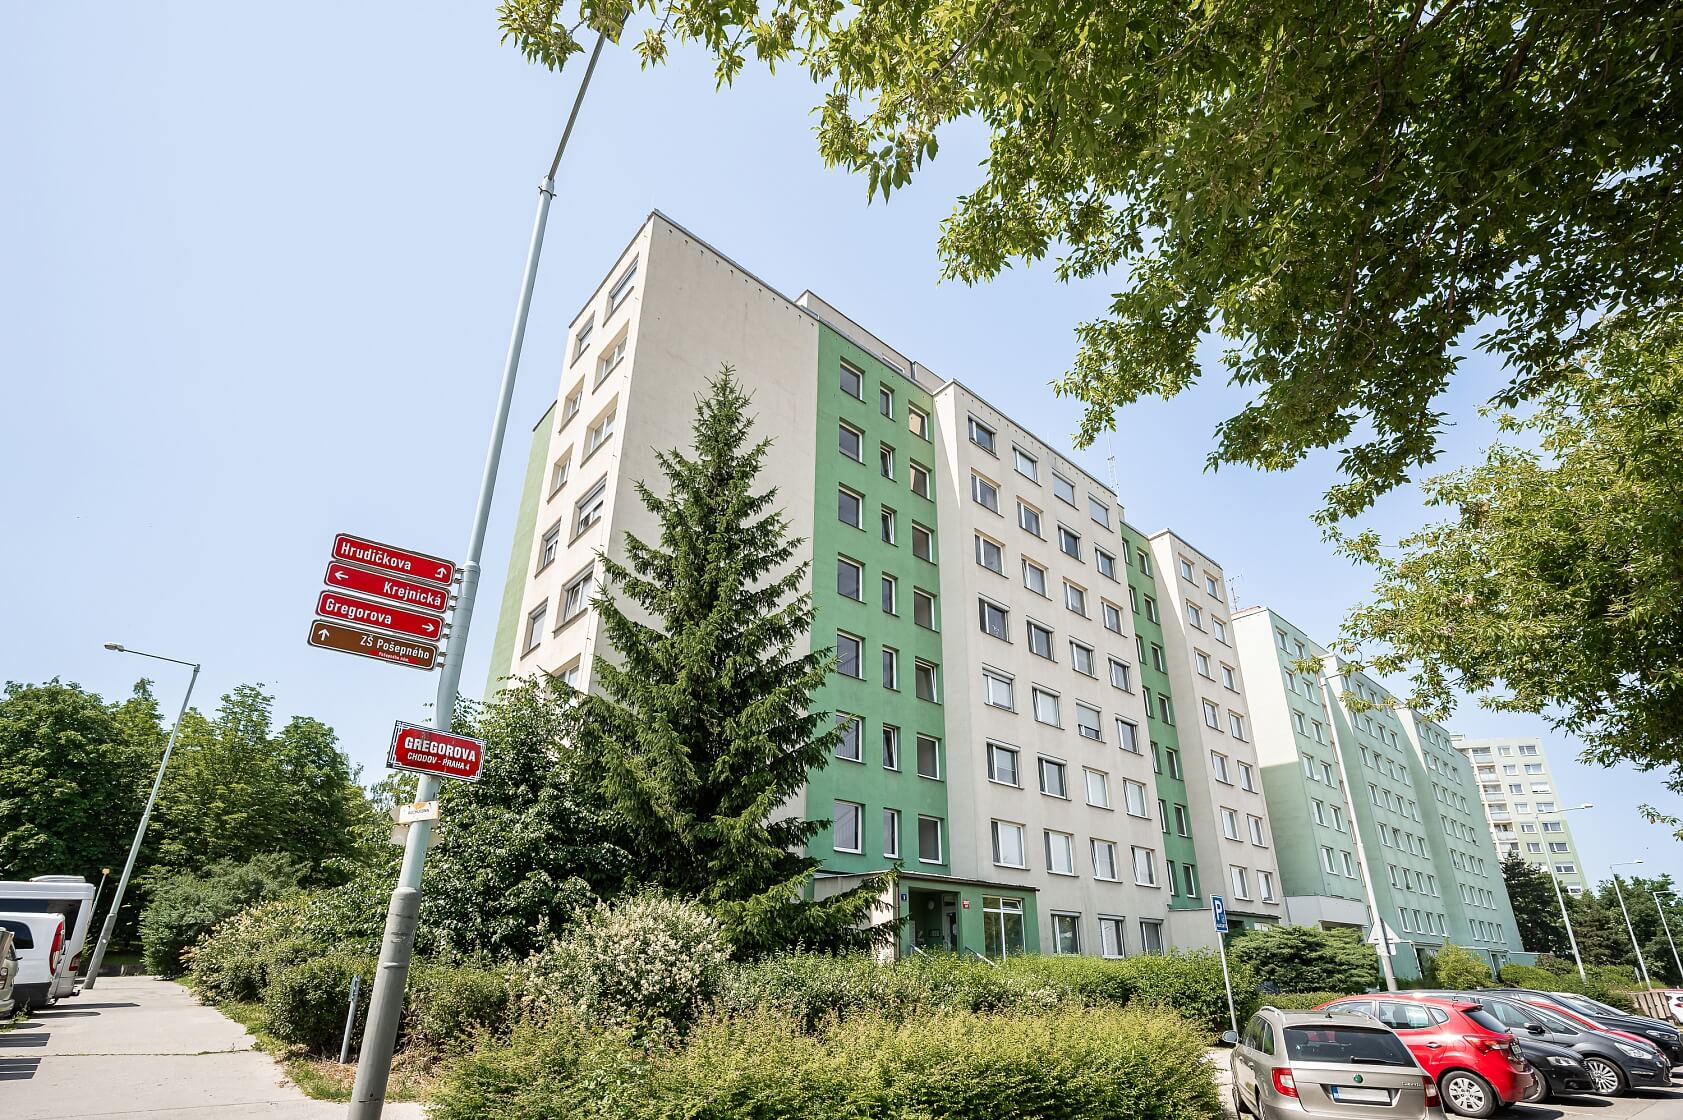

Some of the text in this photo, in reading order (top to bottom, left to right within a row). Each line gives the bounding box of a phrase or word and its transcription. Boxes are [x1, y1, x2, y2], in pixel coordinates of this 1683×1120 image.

[341, 541, 412, 571] Hrudičkova
[383, 581, 441, 607] Krejnická
[325, 598, 392, 625] Gregorova
[360, 634, 430, 660] ZŠ Pošepného
[404, 736, 476, 762] GREGOROVA
[407, 752, 437, 764] CHODOV
[442, 758, 465, 770] PRAHA
[465, 763, 470, 771] 4
[1214, 899, 1223, 921] P
